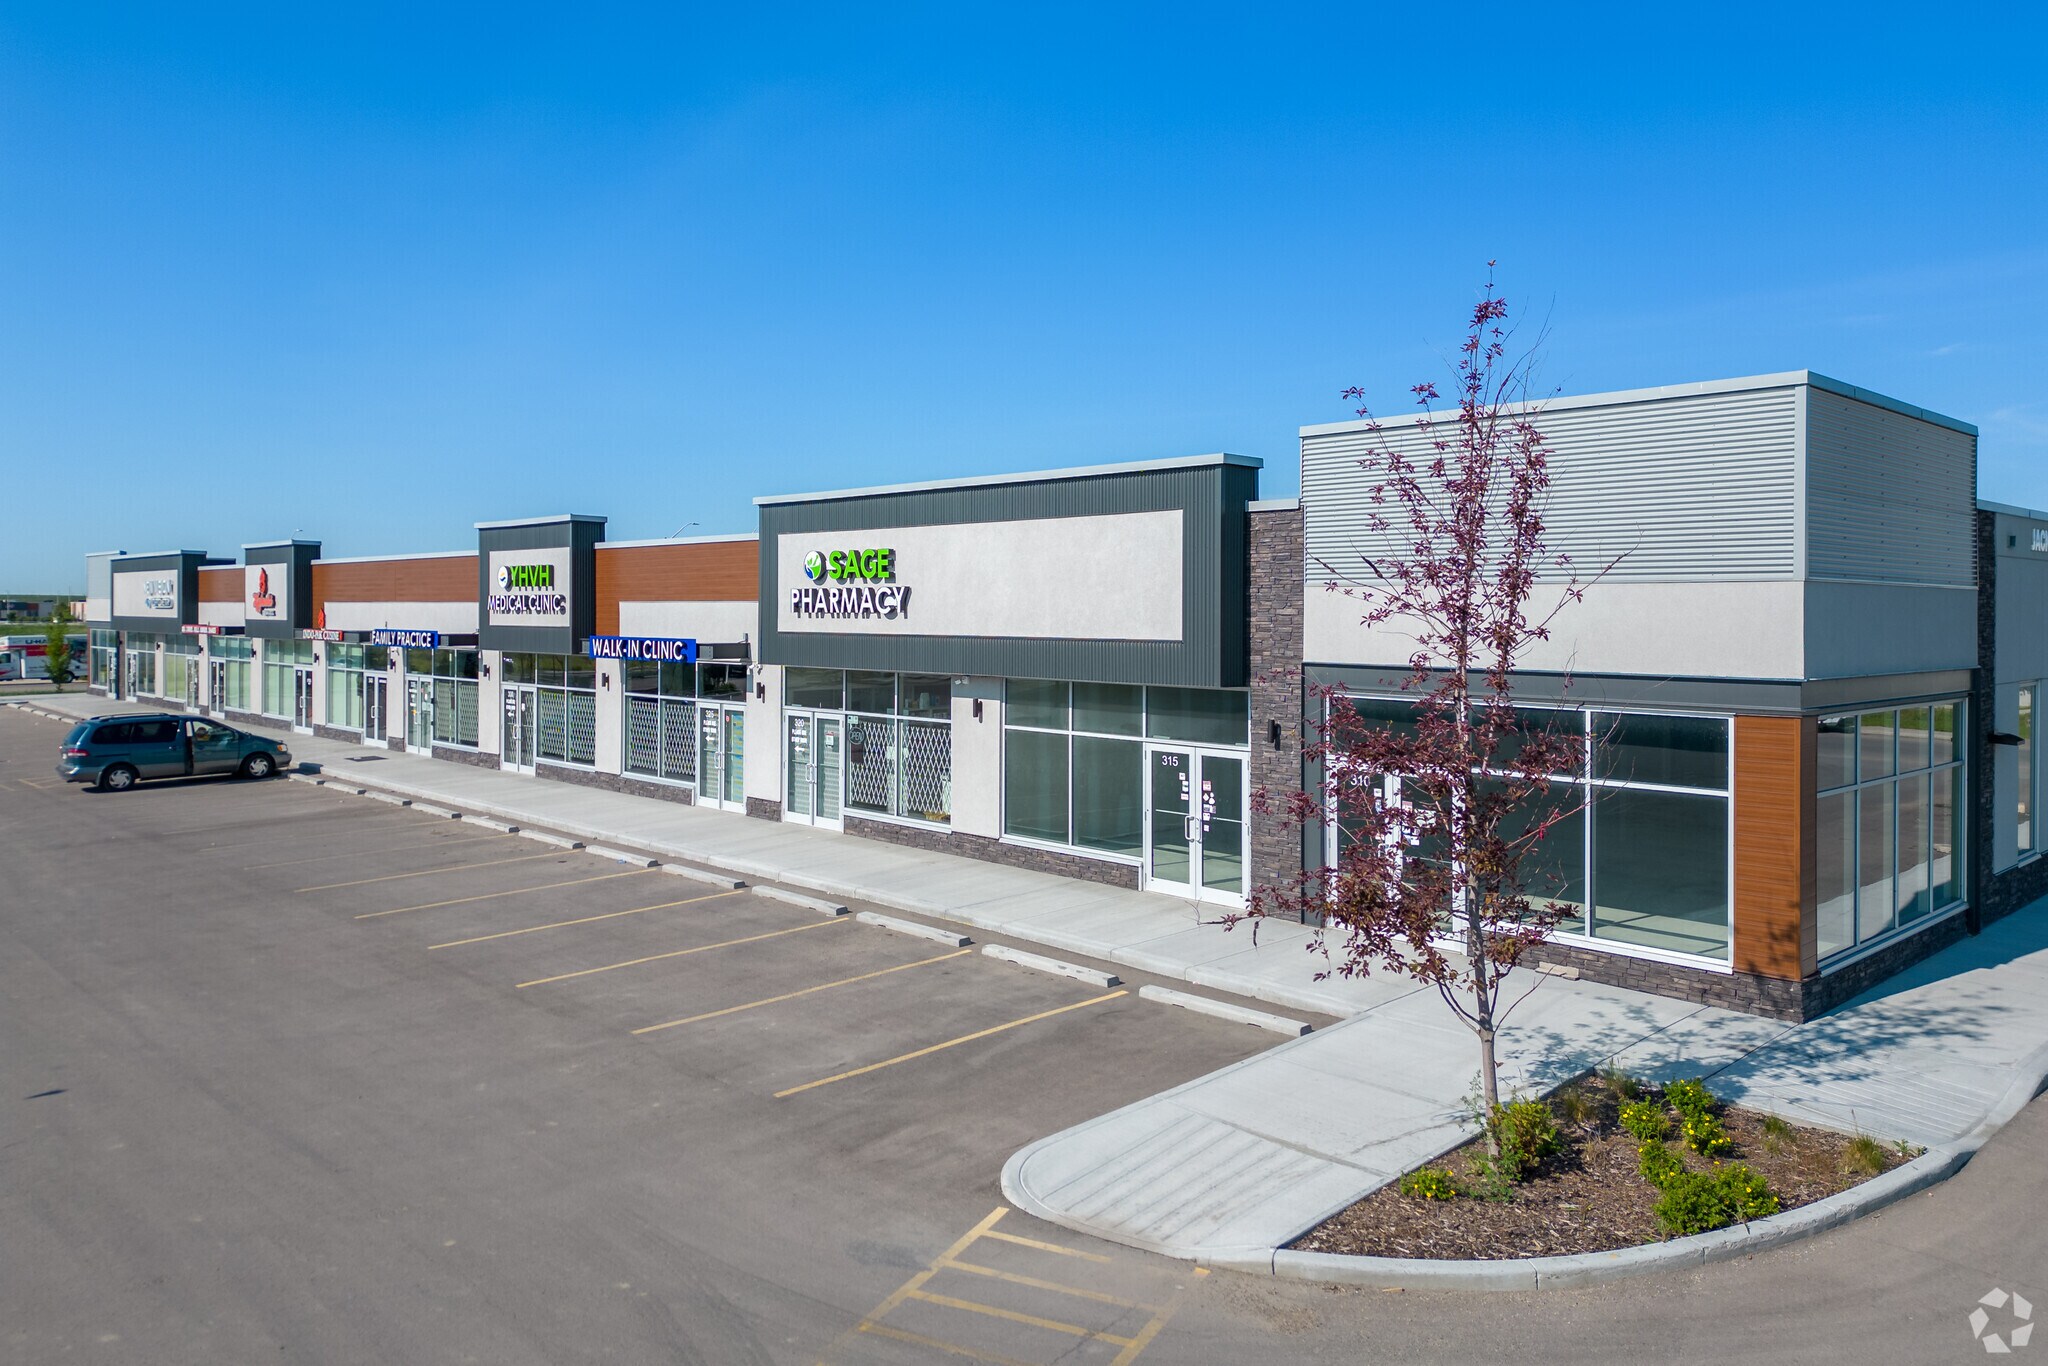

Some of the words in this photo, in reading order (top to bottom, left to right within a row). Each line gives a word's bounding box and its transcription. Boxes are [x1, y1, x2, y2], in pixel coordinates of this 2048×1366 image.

[828, 548, 890, 580] SAGE
[510, 564, 549, 587] YHVH
[487, 595, 527, 611] MEDICAL
[529, 594, 561, 612] CLINIC
[791, 586, 906, 614] PHARMACY
[372, 630, 397, 646] FAMILY
[407, 631, 442, 648] PRACTICE
[592, 638, 640, 658] WALK-IN
[642, 639, 684, 661] CLINIC
[1162, 755, 1178, 767] 315
[1350, 774, 1371, 787] 310
